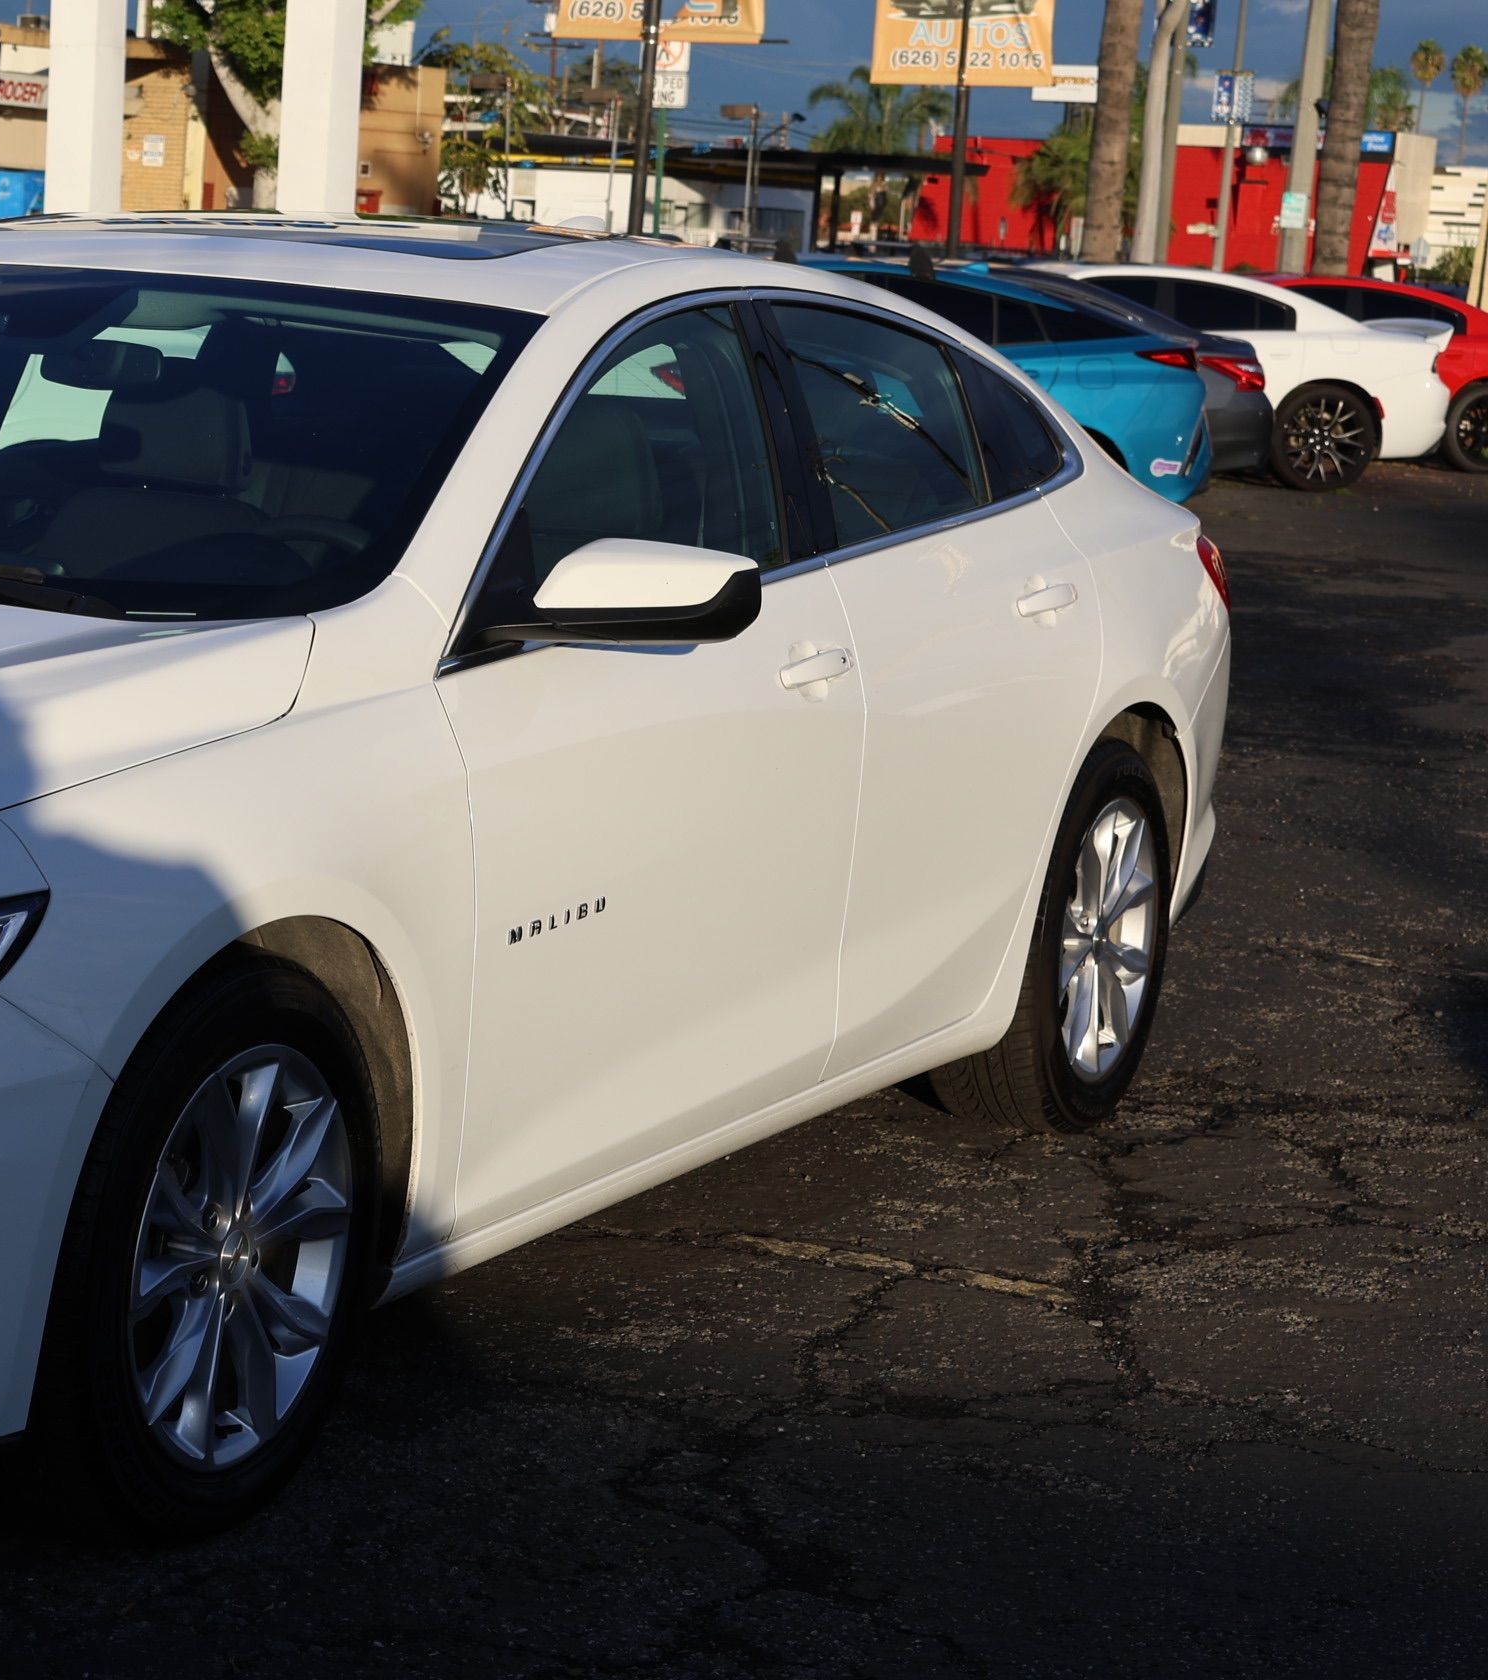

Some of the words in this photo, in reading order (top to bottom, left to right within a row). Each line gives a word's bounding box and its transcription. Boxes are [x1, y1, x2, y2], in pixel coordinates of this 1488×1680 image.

[570, 1, 624, 21] (626)
[891, 50, 940, 68] (626)
[999, 53, 1042, 68] 1015
[663, 78, 684, 89] PED
[508, 896, 606, 945] MALIBU
